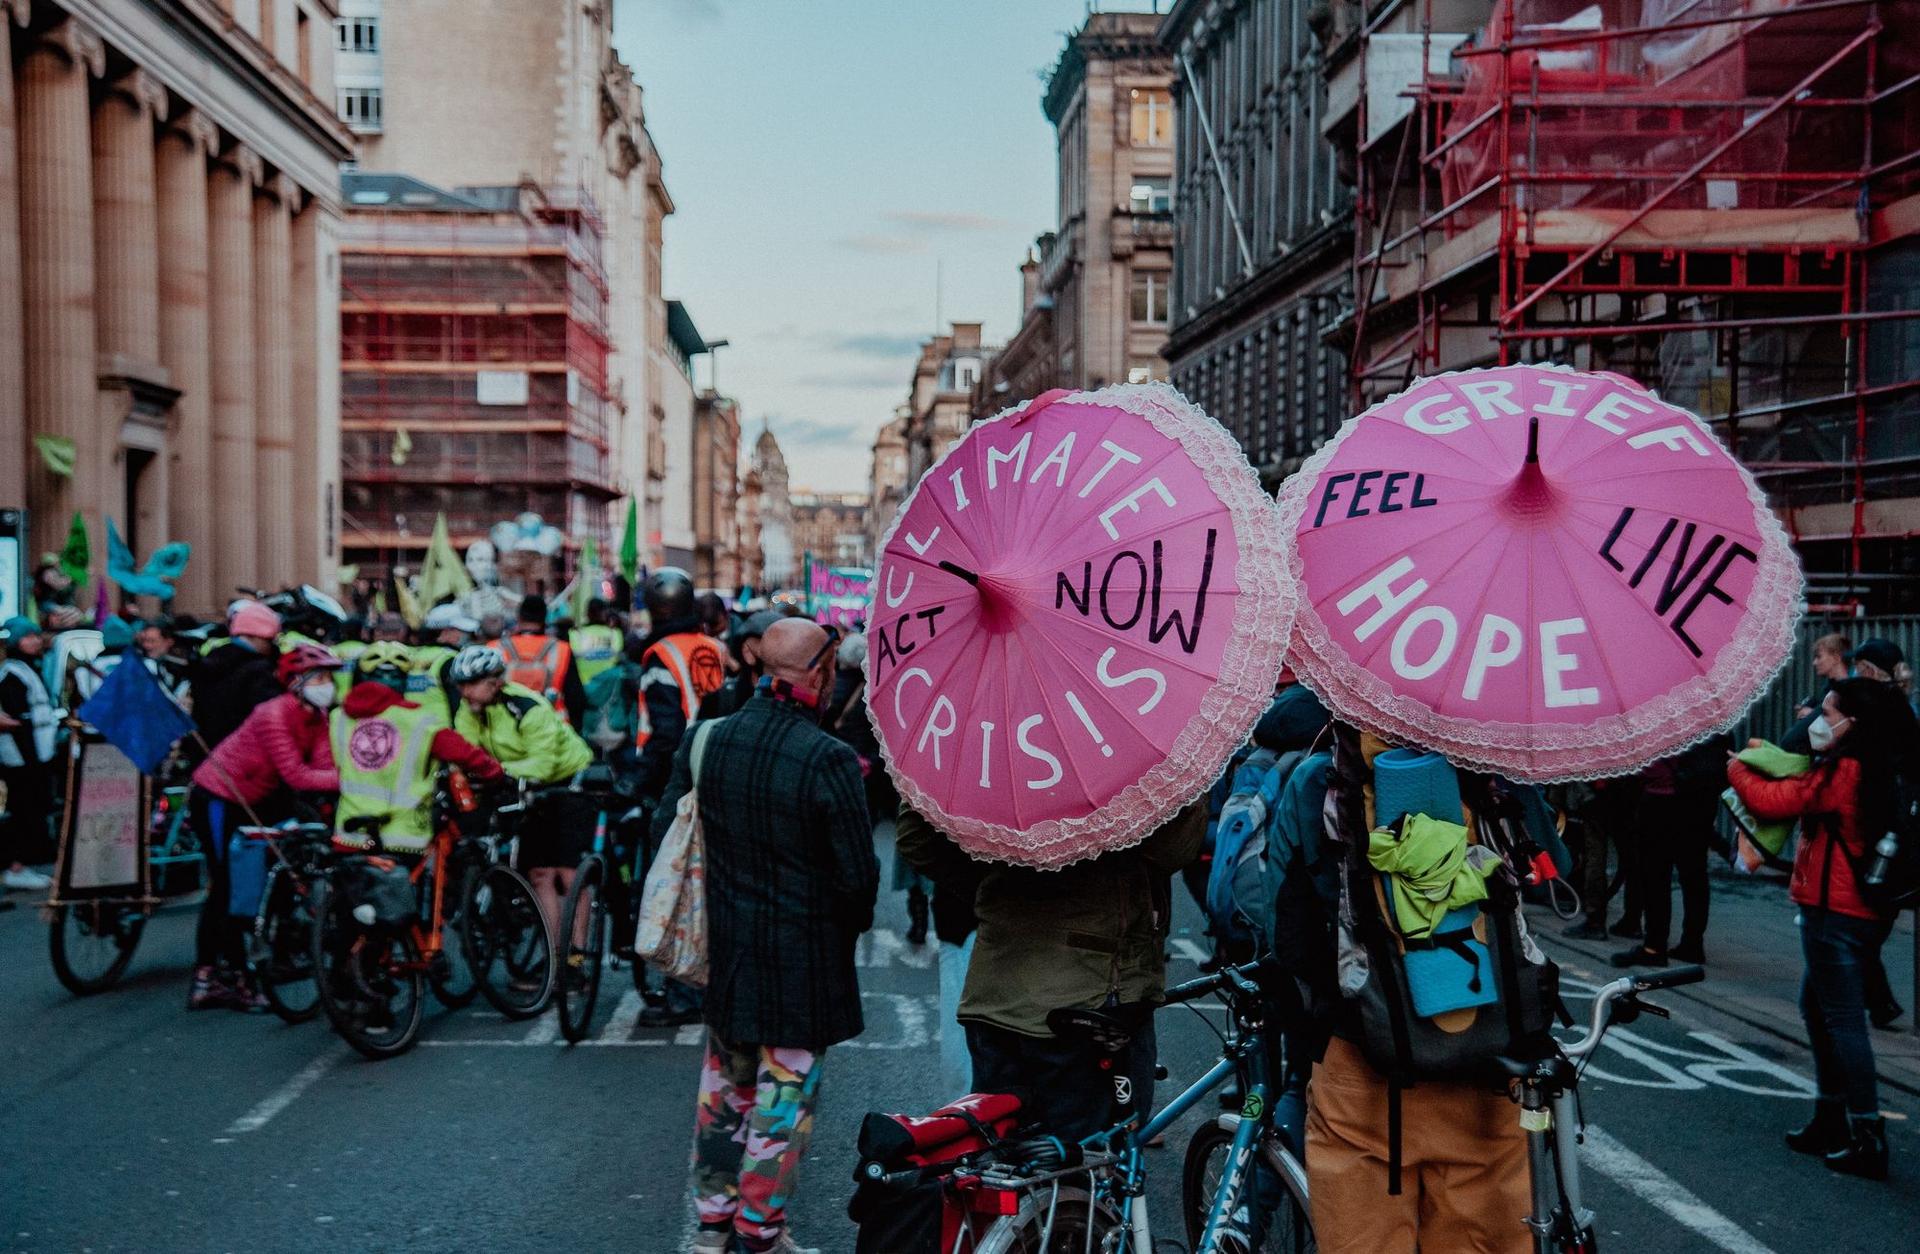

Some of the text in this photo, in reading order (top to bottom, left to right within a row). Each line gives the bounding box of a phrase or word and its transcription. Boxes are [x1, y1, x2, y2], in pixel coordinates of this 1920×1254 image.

[1402, 378, 1712, 458] GRIEF
[887, 431, 1177, 609] CLIMATE
[1313, 470, 1438, 527] FEEL
[1055, 528, 1217, 653] NOW
[1336, 555, 1600, 708] HOPE
[1599, 507, 1758, 658] LIVE
[876, 605, 946, 687] ACT
